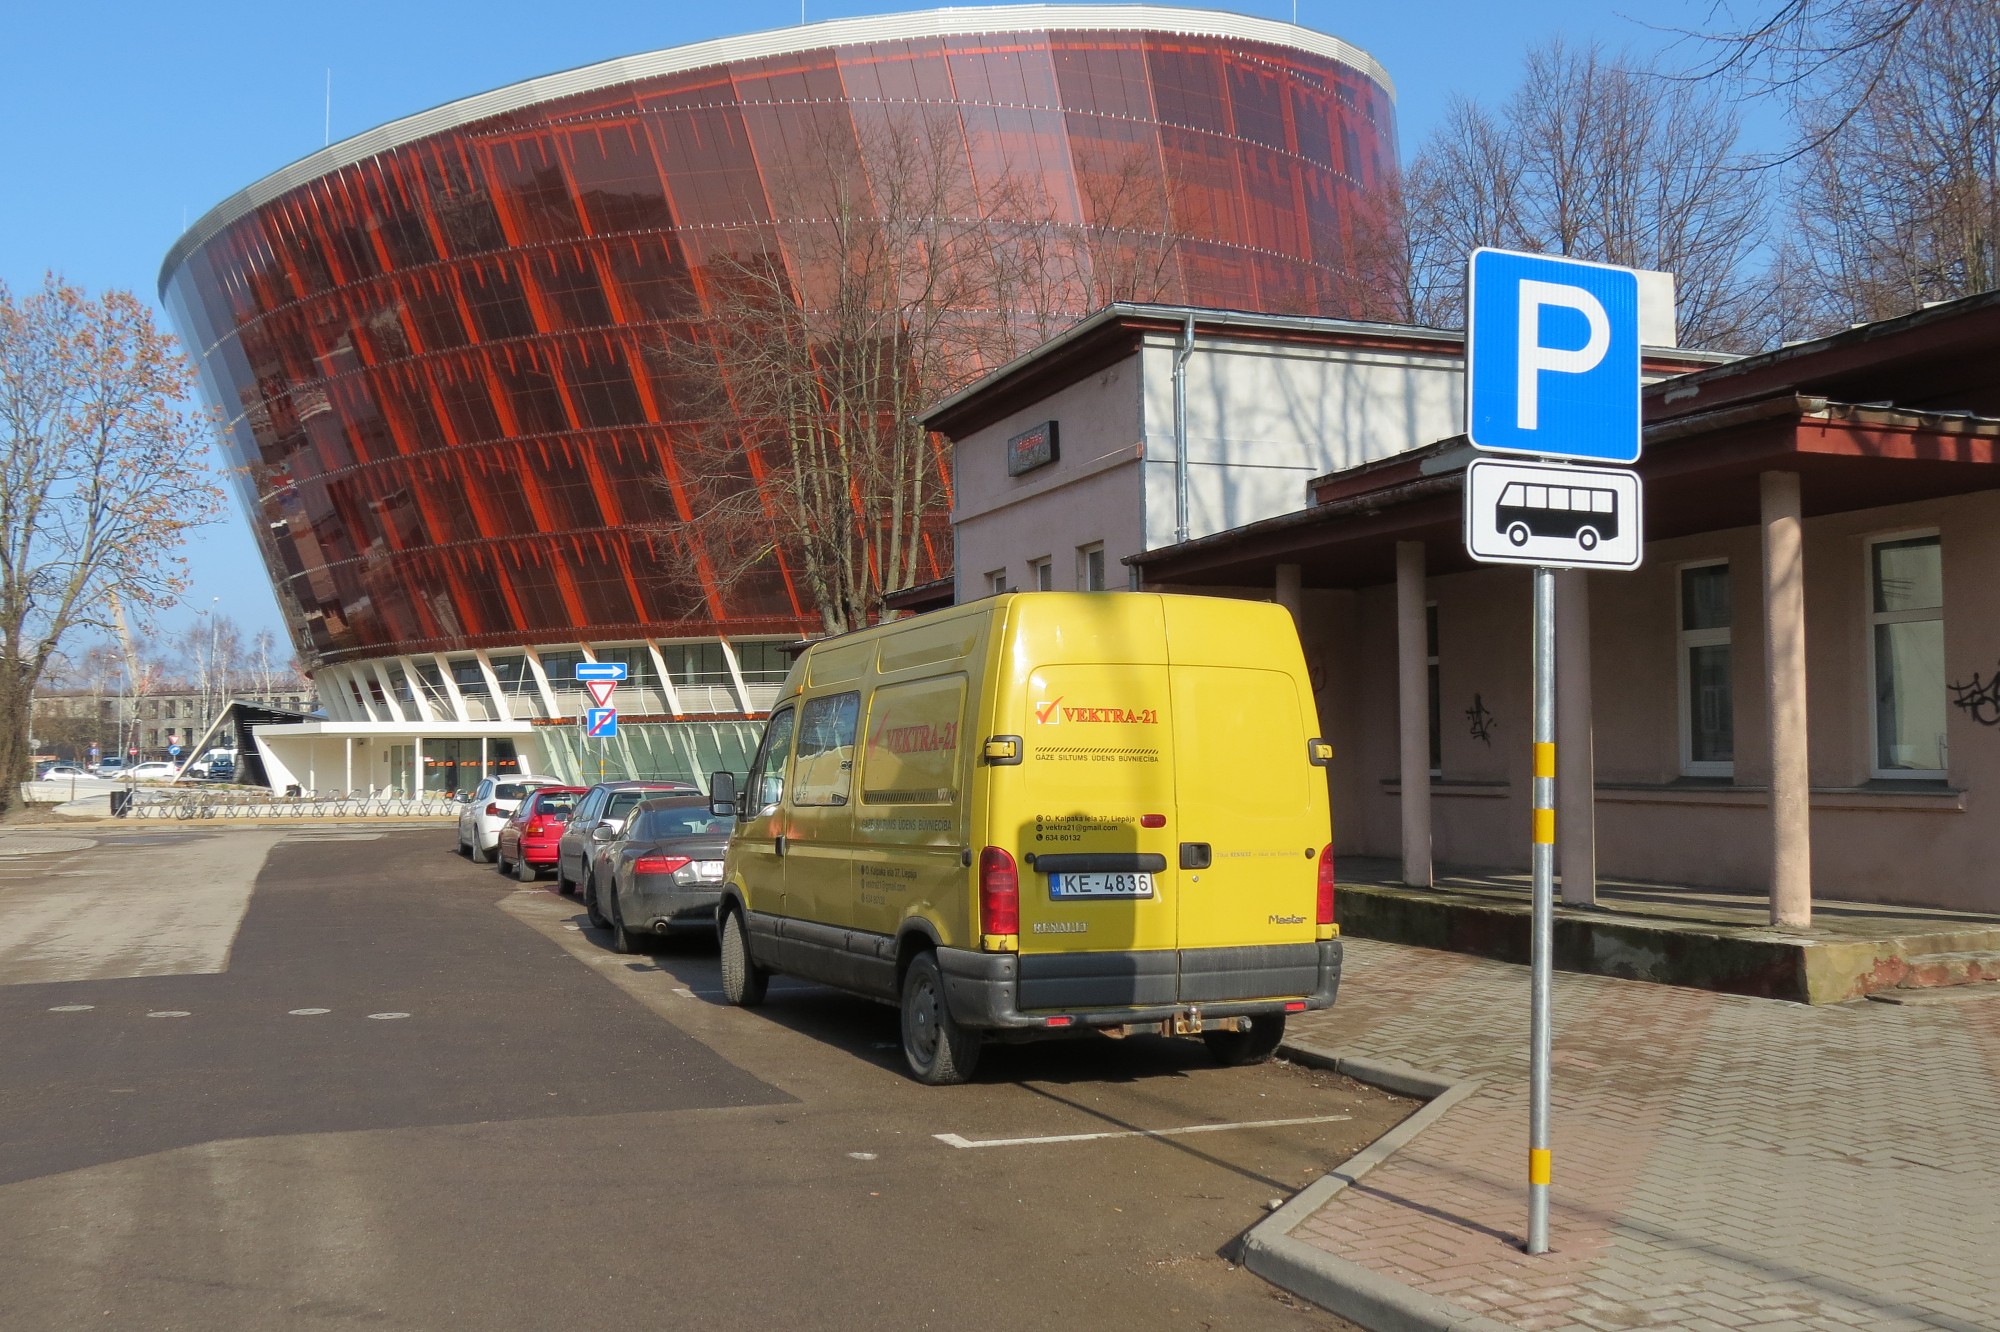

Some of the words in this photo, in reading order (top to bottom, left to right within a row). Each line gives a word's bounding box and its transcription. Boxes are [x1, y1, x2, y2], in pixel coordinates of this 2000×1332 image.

[1517, 278, 1610, 430] P
[595, 711, 612, 734] P
[1063, 707, 1159, 724] VEKTRA-21
[886, 721, 959, 754] VEKTRA-21
[1058, 754, 1088, 762] SILTUMS
[1064, 874, 1149, 893] KE-4836
[1268, 914, 1307, 924] Master
[1033, 923, 1088, 934] RENAULT
